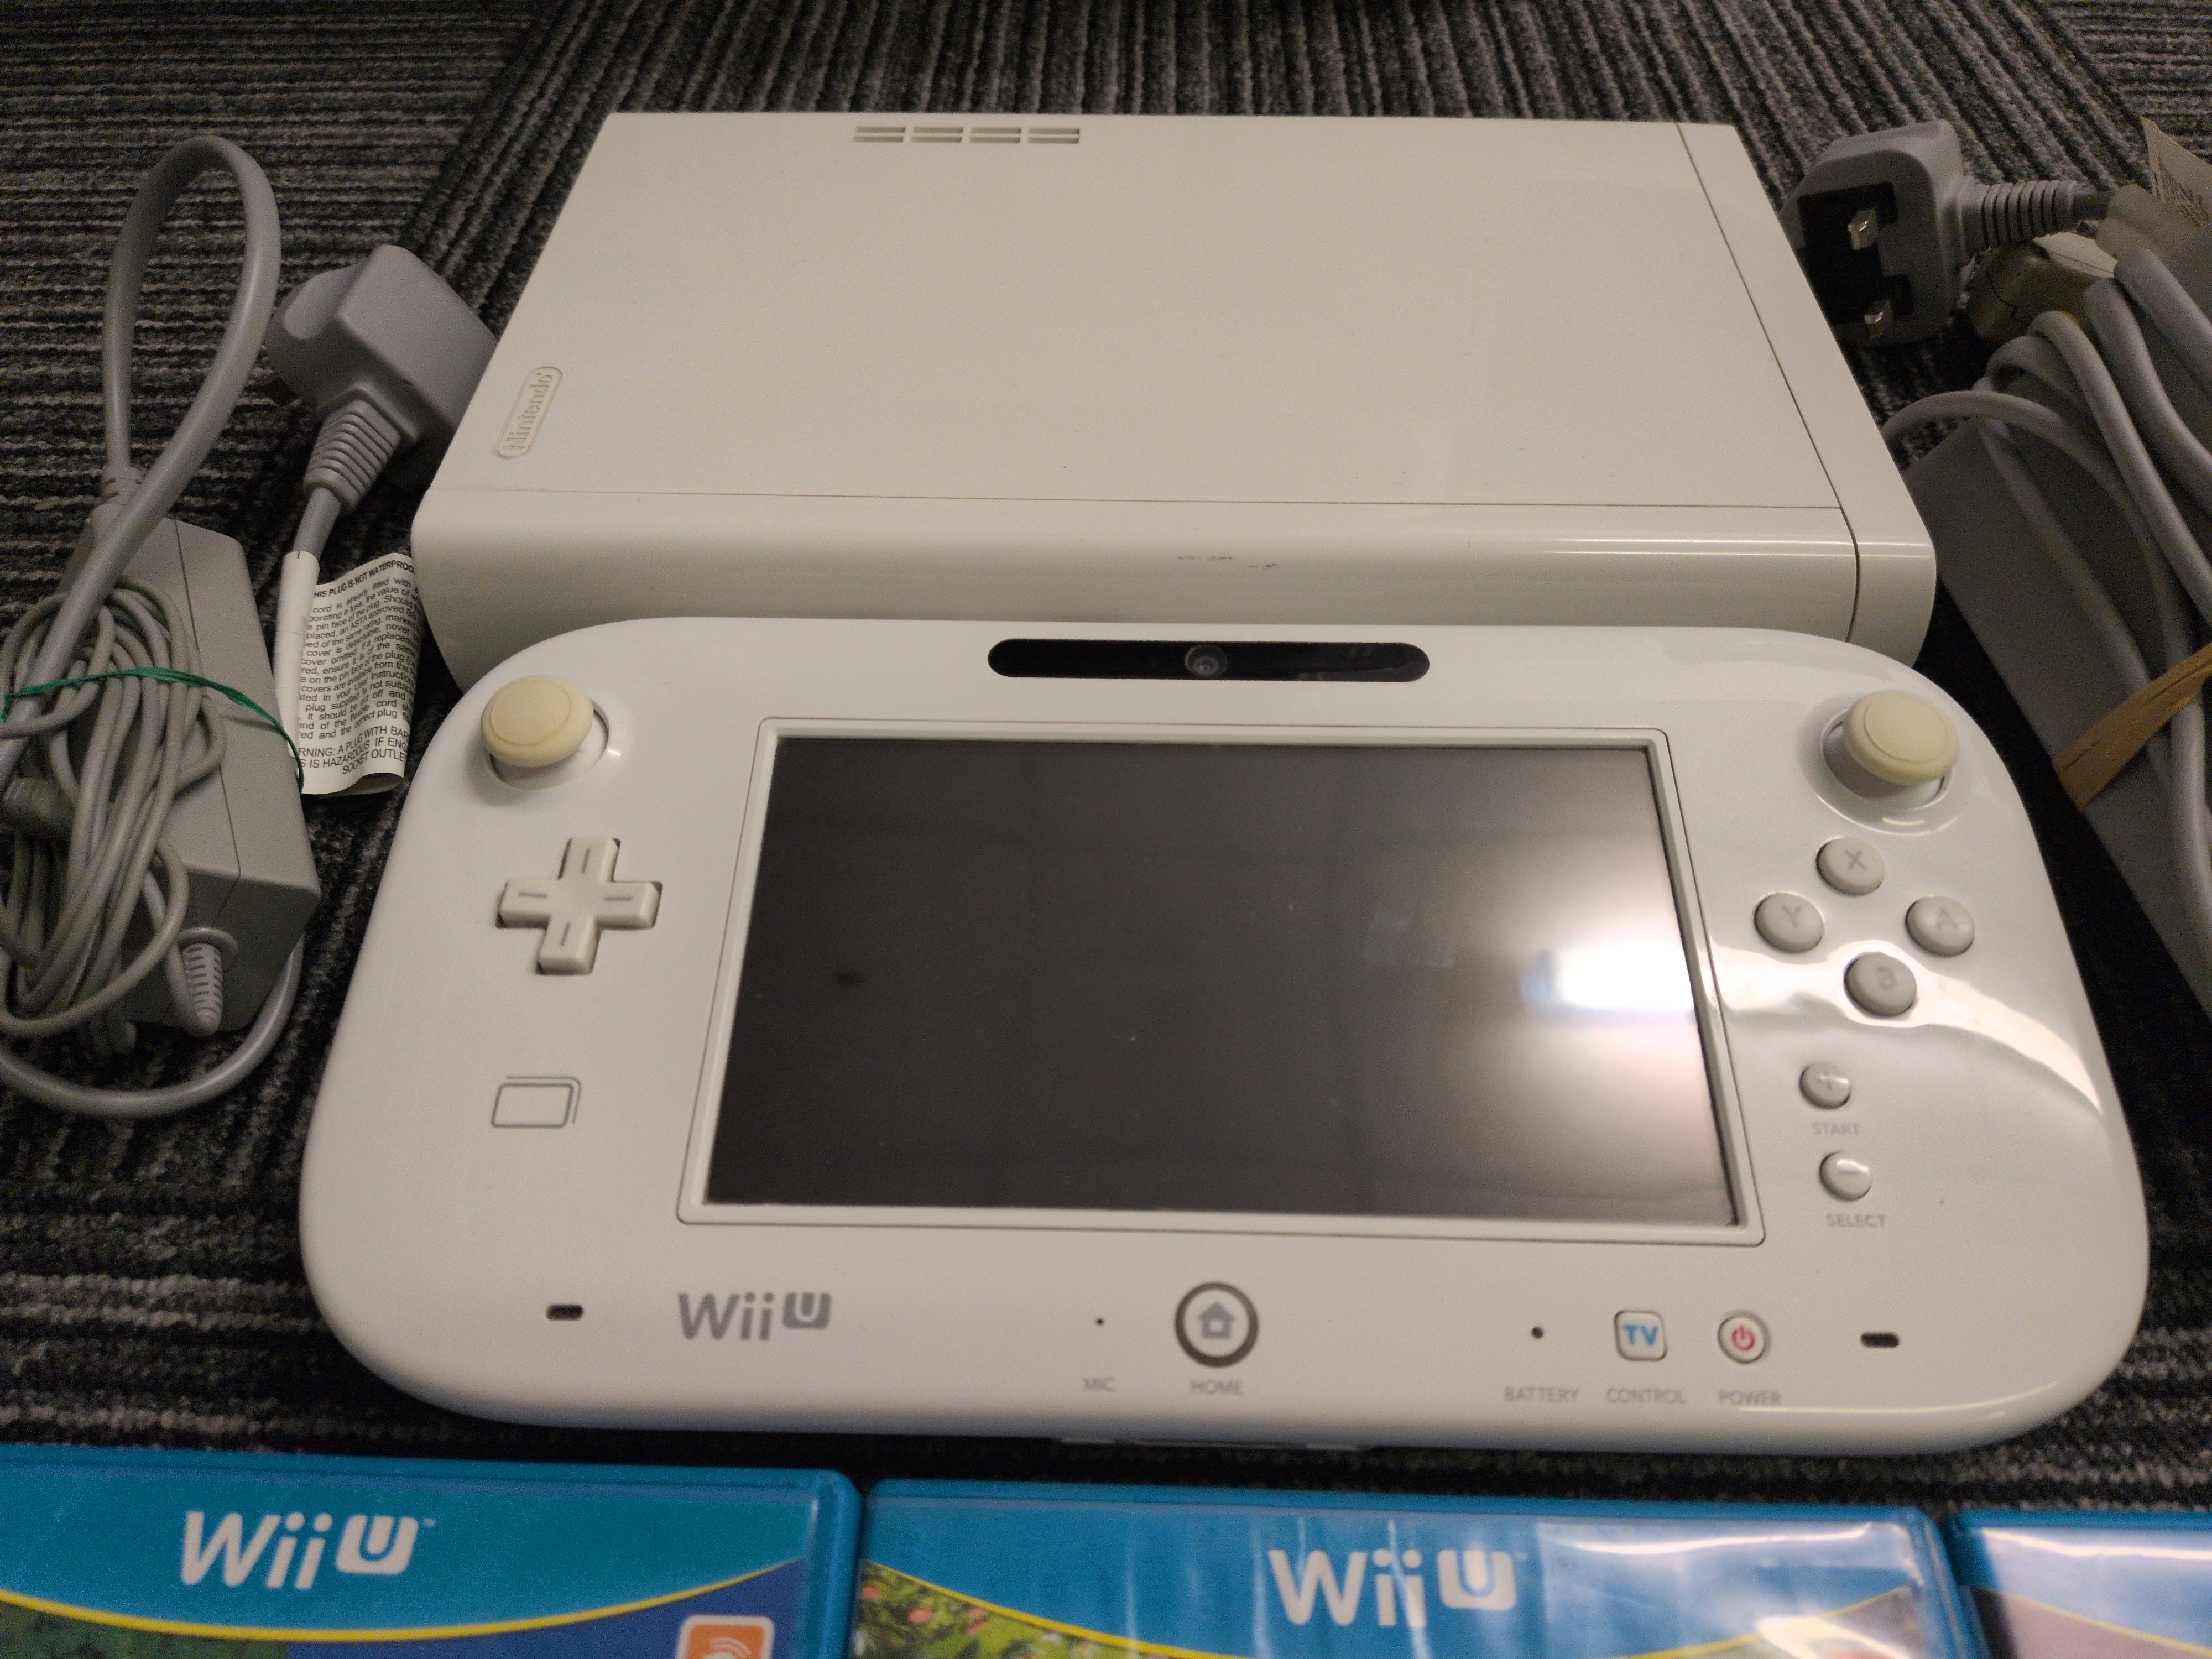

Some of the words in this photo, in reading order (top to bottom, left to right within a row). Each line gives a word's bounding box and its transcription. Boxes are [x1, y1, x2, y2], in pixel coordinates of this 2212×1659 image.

[503, 372, 553, 450] Nintendo
[329, 586, 347, 597] PLUG
[348, 580, 354, 589] IS
[354, 572, 368, 585] NOT
[369, 560, 415, 576] WATERPROO
[313, 605, 332, 613] cord
[346, 589, 369, 606] already
[373, 578, 389, 591] fitted
[394, 578, 411, 589] with
[367, 594, 376, 603] the
[378, 587, 399, 597] value
[332, 619, 347, 628] face
[349, 612, 355, 622] of
[356, 609, 366, 618] the
[351, 615, 367, 628] ASTA
[369, 606, 404, 619] approved
[332, 638, 344, 646] the
[346, 629, 362, 641] same
[386, 624, 410, 634] never
[323, 661, 349, 674] ensure
[367, 645, 374, 655] of
[377, 642, 390, 650] the
[339, 671, 349, 681] pin
[372, 653, 383, 662] the
[385, 650, 404, 663] plug
[334, 682, 346, 691] are
[375, 661, 393, 670] from
[396, 661, 408, 672] the
[336, 688, 351, 701] your
[372, 670, 415, 684] instruction
[306, 703, 326, 712] plug
[331, 691, 360, 710] supplied
[370, 680, 383, 690] not
[319, 709, 347, 721] should
[350, 704, 358, 712] be
[373, 689, 384, 699] off
[389, 691, 406, 701] and
[319, 730, 336, 739] and
[341, 726, 352, 735] the
[354, 710, 375, 728] correct
[377, 708, 398, 719] plug
[321, 721, 330, 729] of
[335, 719, 347, 728] the
[338, 745, 344, 754] A
[346, 733, 363, 750] PLUG
[364, 726, 388, 739] WITH
[391, 726, 409, 739] BAR
[310, 759, 320, 768] IS
[323, 740, 370, 768] HAZARDOUS
[375, 737, 385, 747] IF
[343, 751, 369, 775] SOCKET
[1845, 850, 1866, 870] X
[1782, 905, 1802, 927] Y
[1936, 909, 1959, 930] A
[1876, 966, 1898, 989] B
[1811, 1120, 1860, 1135] START
[1827, 1213, 1885, 1228] SELECT
[678, 1292, 775, 1341] Wii
[781, 1292, 833, 1331] U
[1622, 1323, 1658, 1345] TV
[1083, 1376, 1114, 1392] MIC
[1191, 1380, 1242, 1396] HOME
[1504, 1386, 1580, 1403] BATTERY
[1606, 1387, 1686, 1404] CONTROL
[1718, 1390, 1782, 1406] POWER
[180, 1510, 333, 1590] Wii
[336, 1513, 419, 1575] U
[1267, 1548, 1426, 1627] Wii
[1438, 1549, 1517, 1610] U
